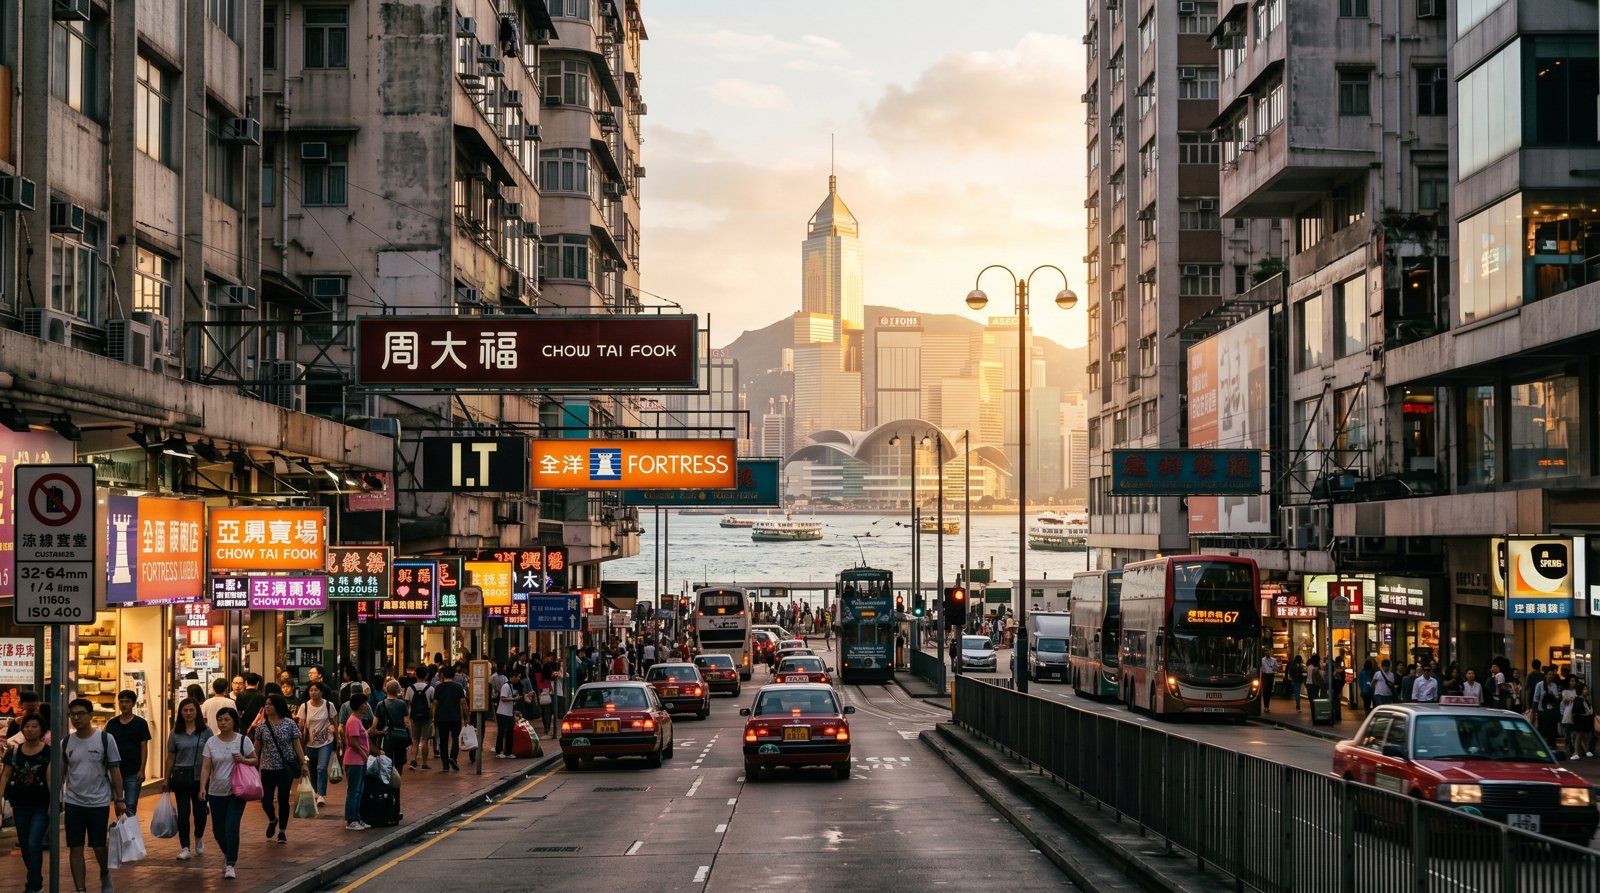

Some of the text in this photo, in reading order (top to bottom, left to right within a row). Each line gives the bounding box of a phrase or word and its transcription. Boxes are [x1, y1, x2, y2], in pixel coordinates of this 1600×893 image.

[381, 330, 677, 370] 周大福 CHOW TAI FOOK
[451, 442, 497, 487] I.T
[540, 455, 729, 475] 全洋 FORTRESS
[216, 548, 318, 560] CHOW TAI FOOK
[21, 567, 88, 579] 32-64mm
[142, 561, 178, 582] FORTRESS
[253, 597, 280, 606] CHOW
[282, 597, 295, 606] TAI
[28, 607, 82, 618] ISO 400
[1224, 611, 1240, 623] 67
